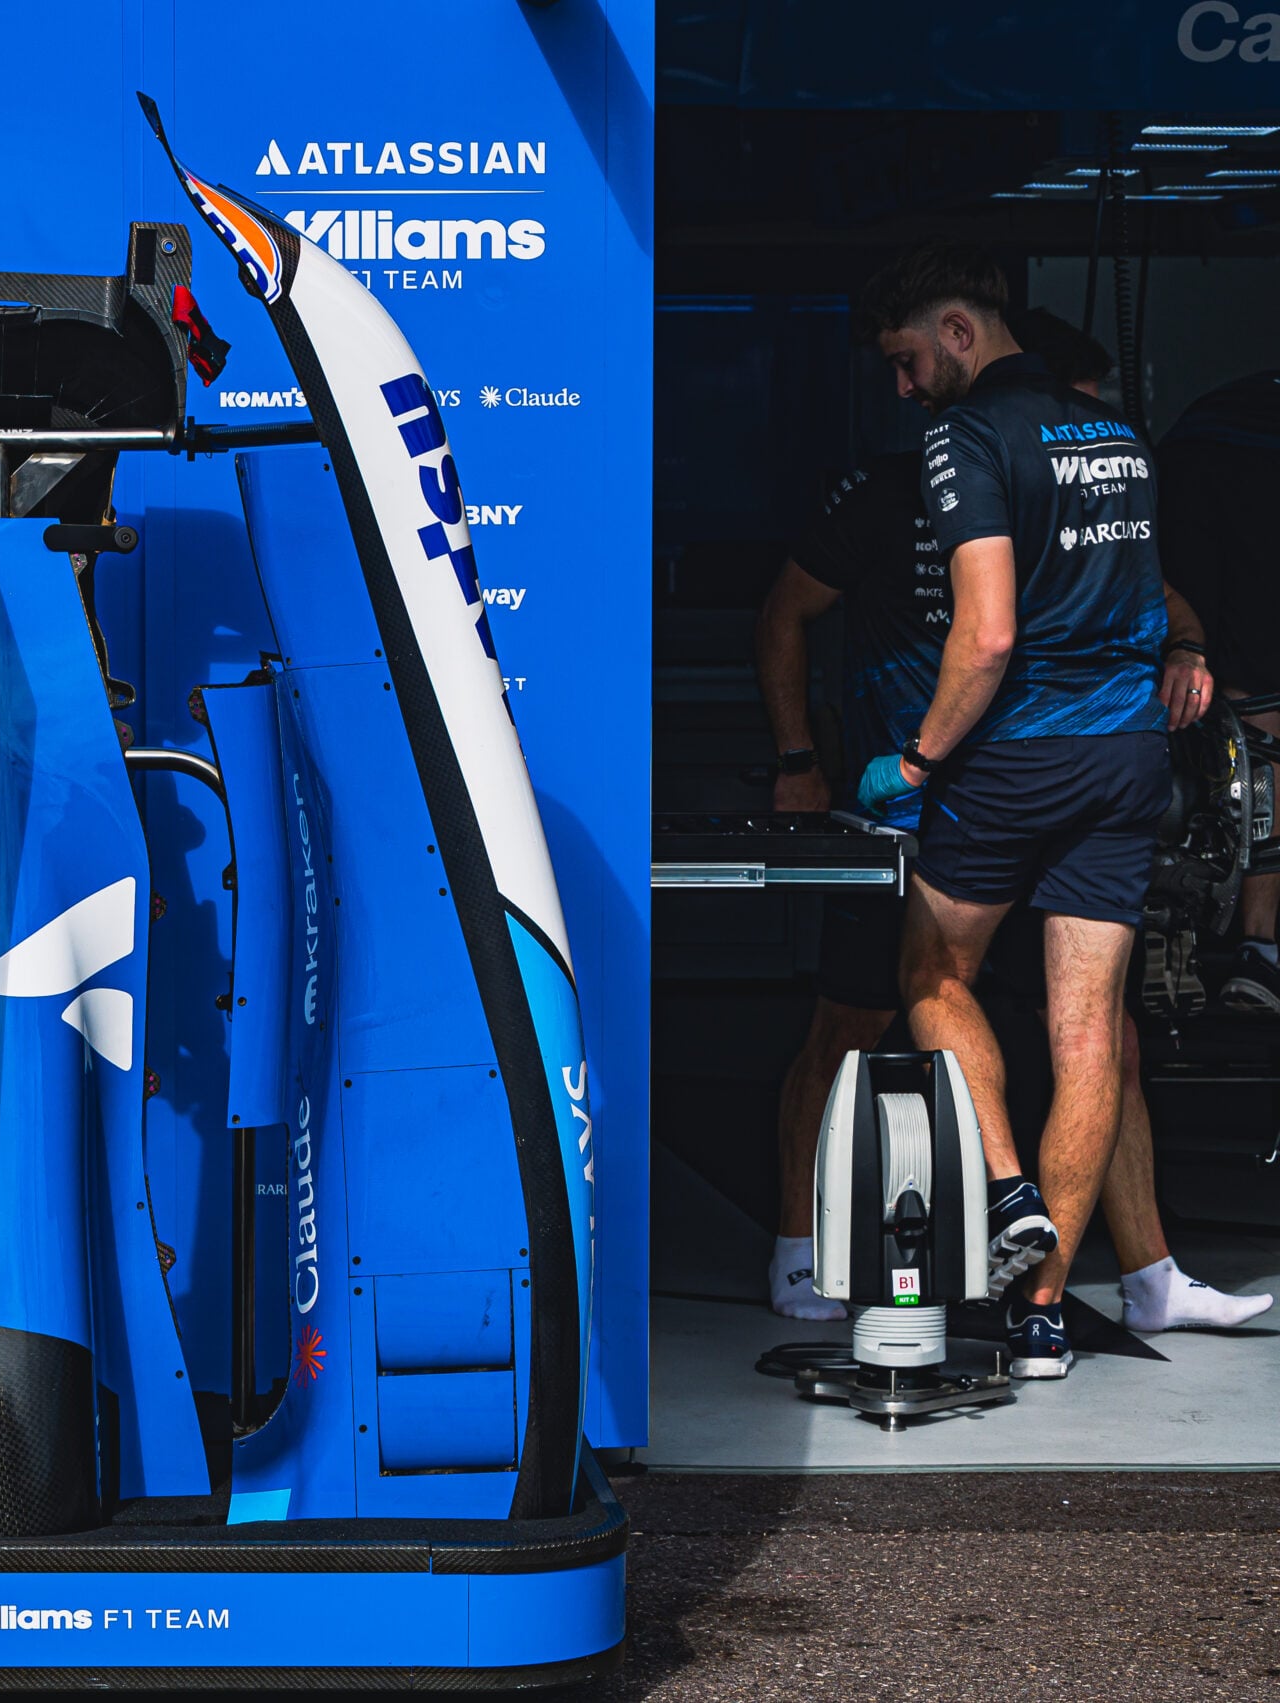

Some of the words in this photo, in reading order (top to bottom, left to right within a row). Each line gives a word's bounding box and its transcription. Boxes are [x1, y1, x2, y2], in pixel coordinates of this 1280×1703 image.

[1178, 0, 1280, 63] Ca
[297, 141, 546, 175] ATLASSIAN
[383, 270, 463, 290] TEAM
[220, 387, 308, 408] KOMATS
[505, 387, 581, 407] Claude
[1090, 482, 1128, 497] TEAM
[464, 505, 523, 525] BNY
[1080, 520, 1151, 547] ARCLAYS
[482, 588, 527, 610] way
[293, 773, 318, 971] kraken
[294, 1096, 319, 1315] Claude
[899, 1276, 914, 1289] B1
[104, 1609, 133, 1630] F1
[145, 1609, 231, 1630] TEAM
